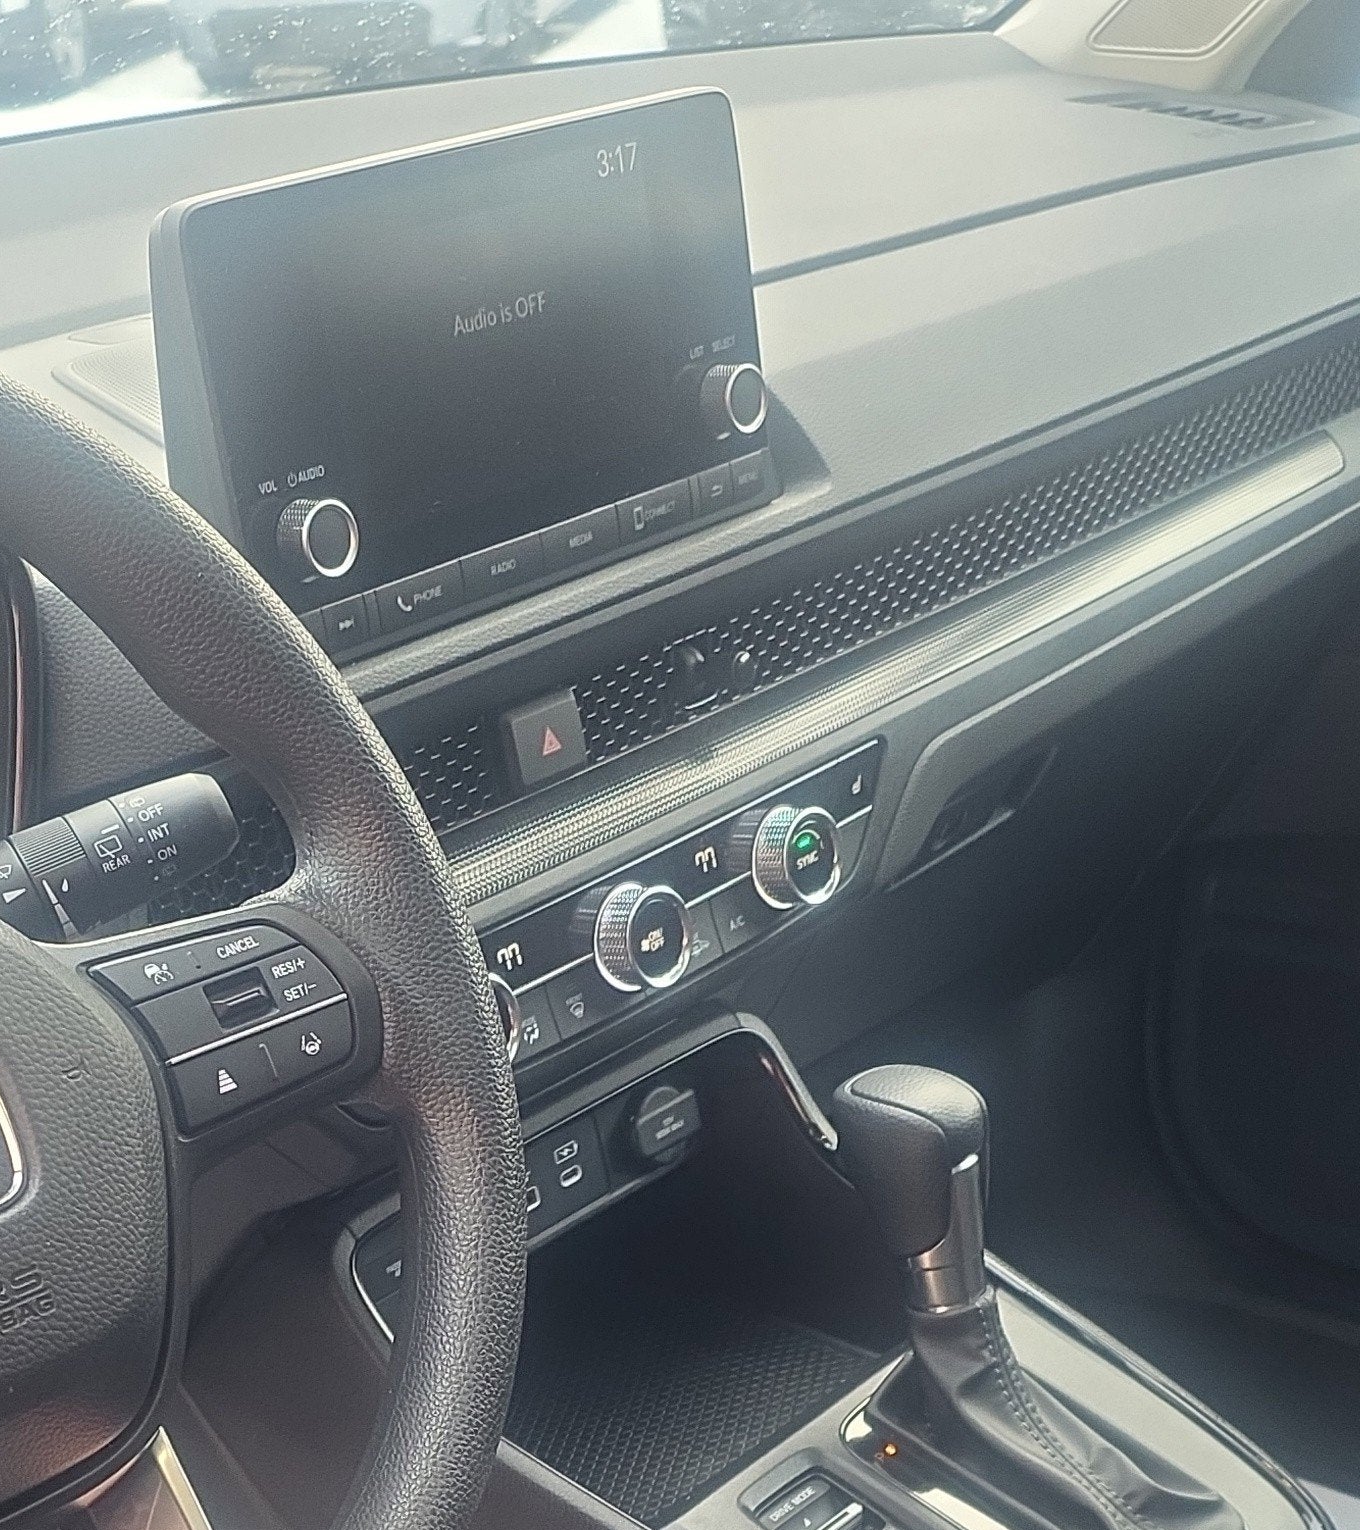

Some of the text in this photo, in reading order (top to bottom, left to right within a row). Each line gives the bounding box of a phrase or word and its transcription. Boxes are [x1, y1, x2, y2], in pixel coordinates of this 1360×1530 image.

[597, 142, 638, 178] 3:17
[454, 291, 546, 336] Audio is OFF
[258, 464, 325, 495] VOL AUDIO
[414, 585, 442, 605] PHONE
[138, 803, 164, 823] OFF
[147, 823, 171, 843] INT
[157, 844, 178, 861] ON
[102, 854, 131, 873] REAR
[216, 935, 259, 959] CANCEL
[769, 1499, 795, 1522] DRIVE
